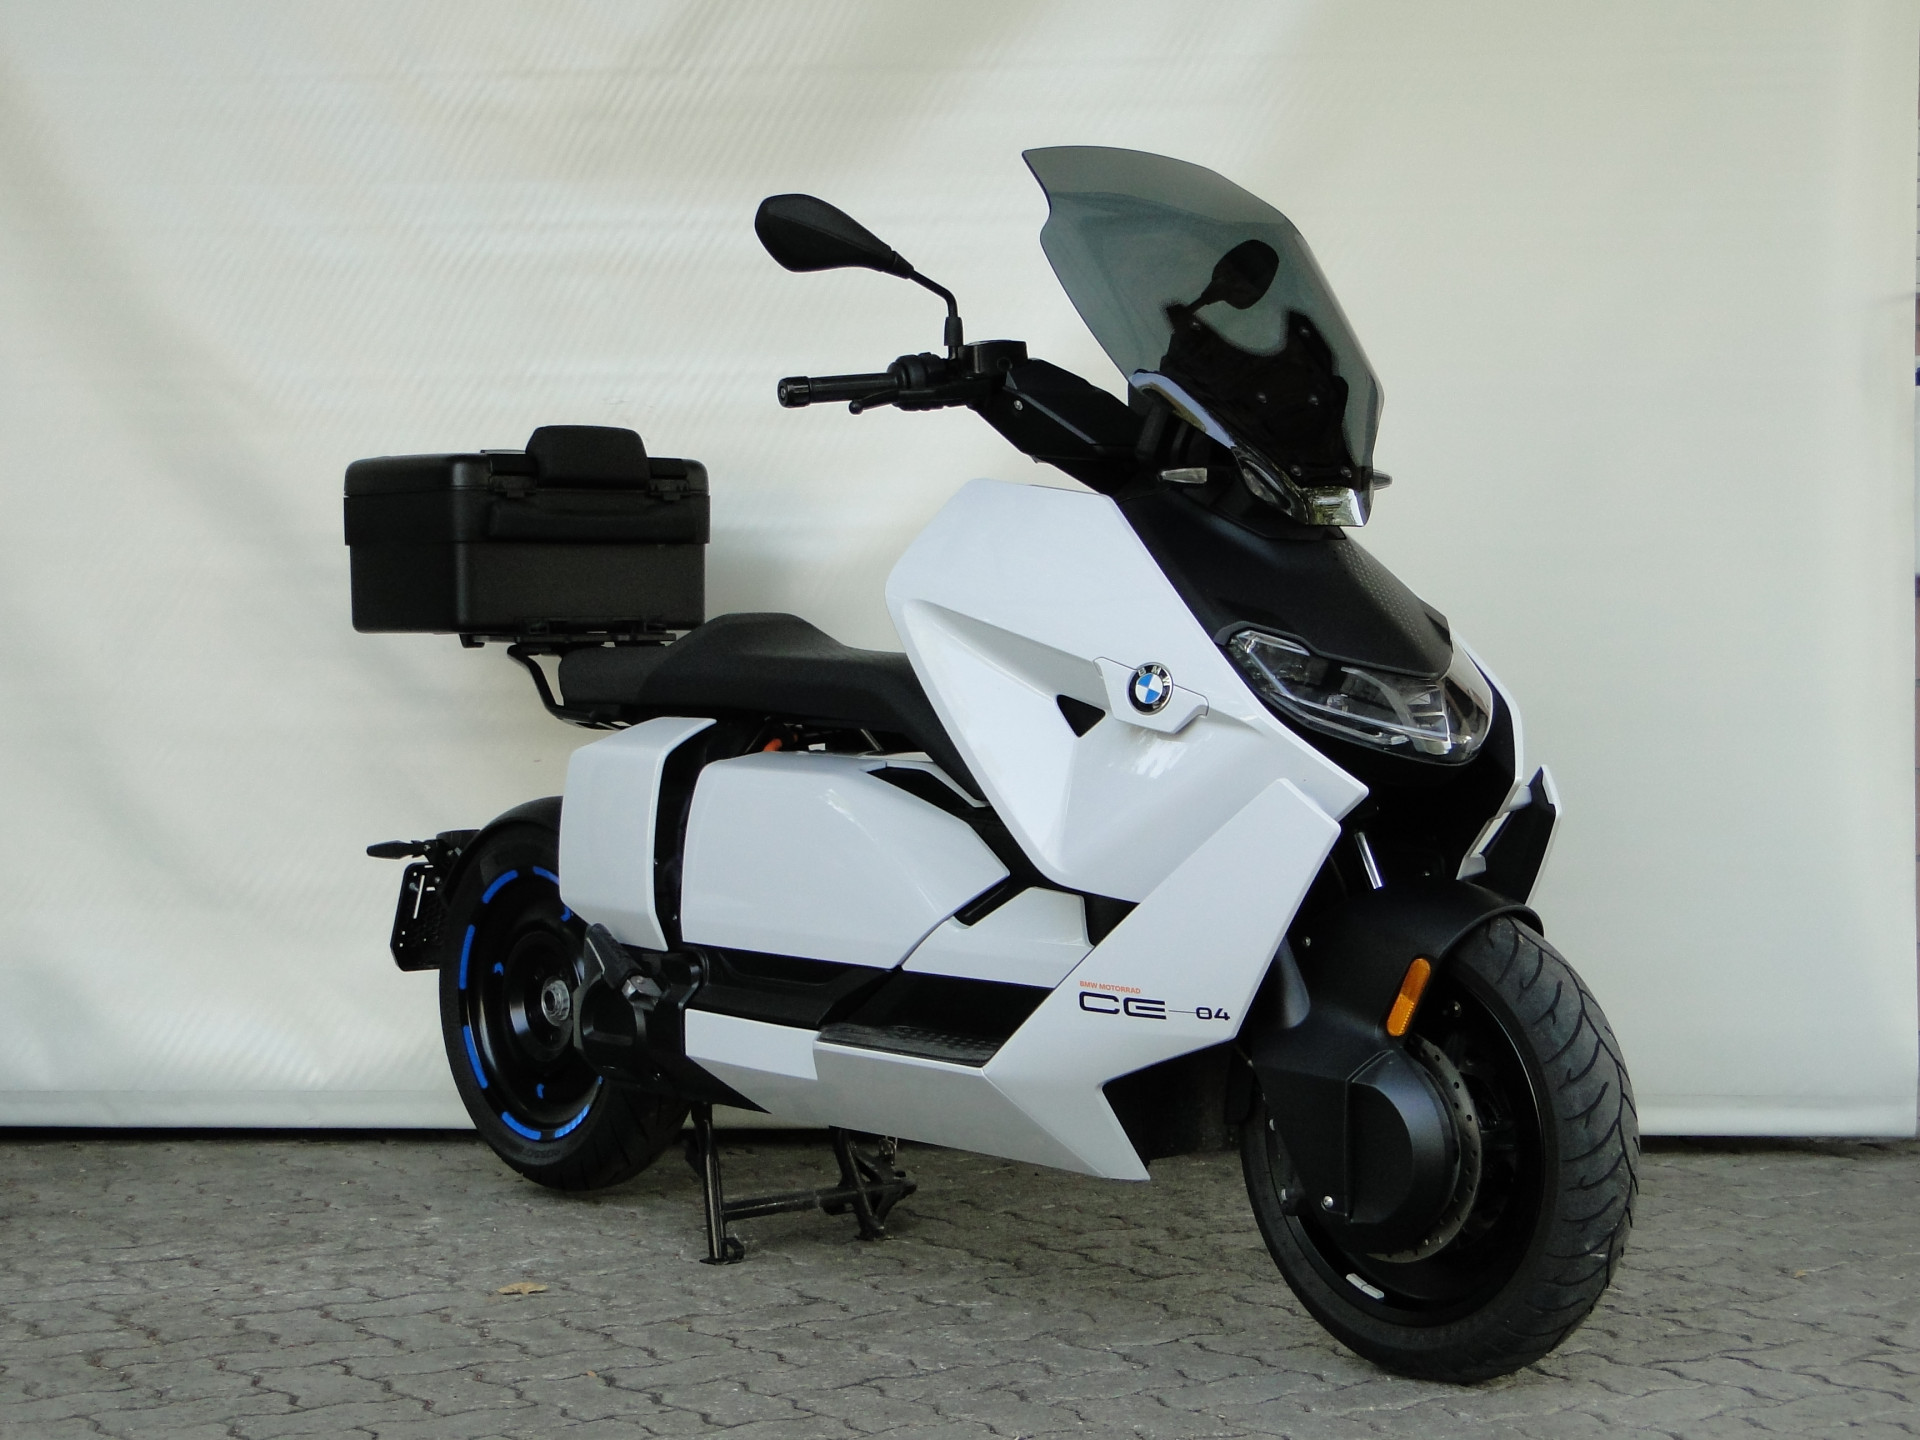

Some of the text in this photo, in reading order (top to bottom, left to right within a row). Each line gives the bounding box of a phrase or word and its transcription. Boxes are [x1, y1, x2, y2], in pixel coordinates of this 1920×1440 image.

[1138, 665, 1171, 687] BMW
[1079, 980, 1141, 995] BMW MOTORRAD
[1078, 991, 1231, 1021] CE 04
